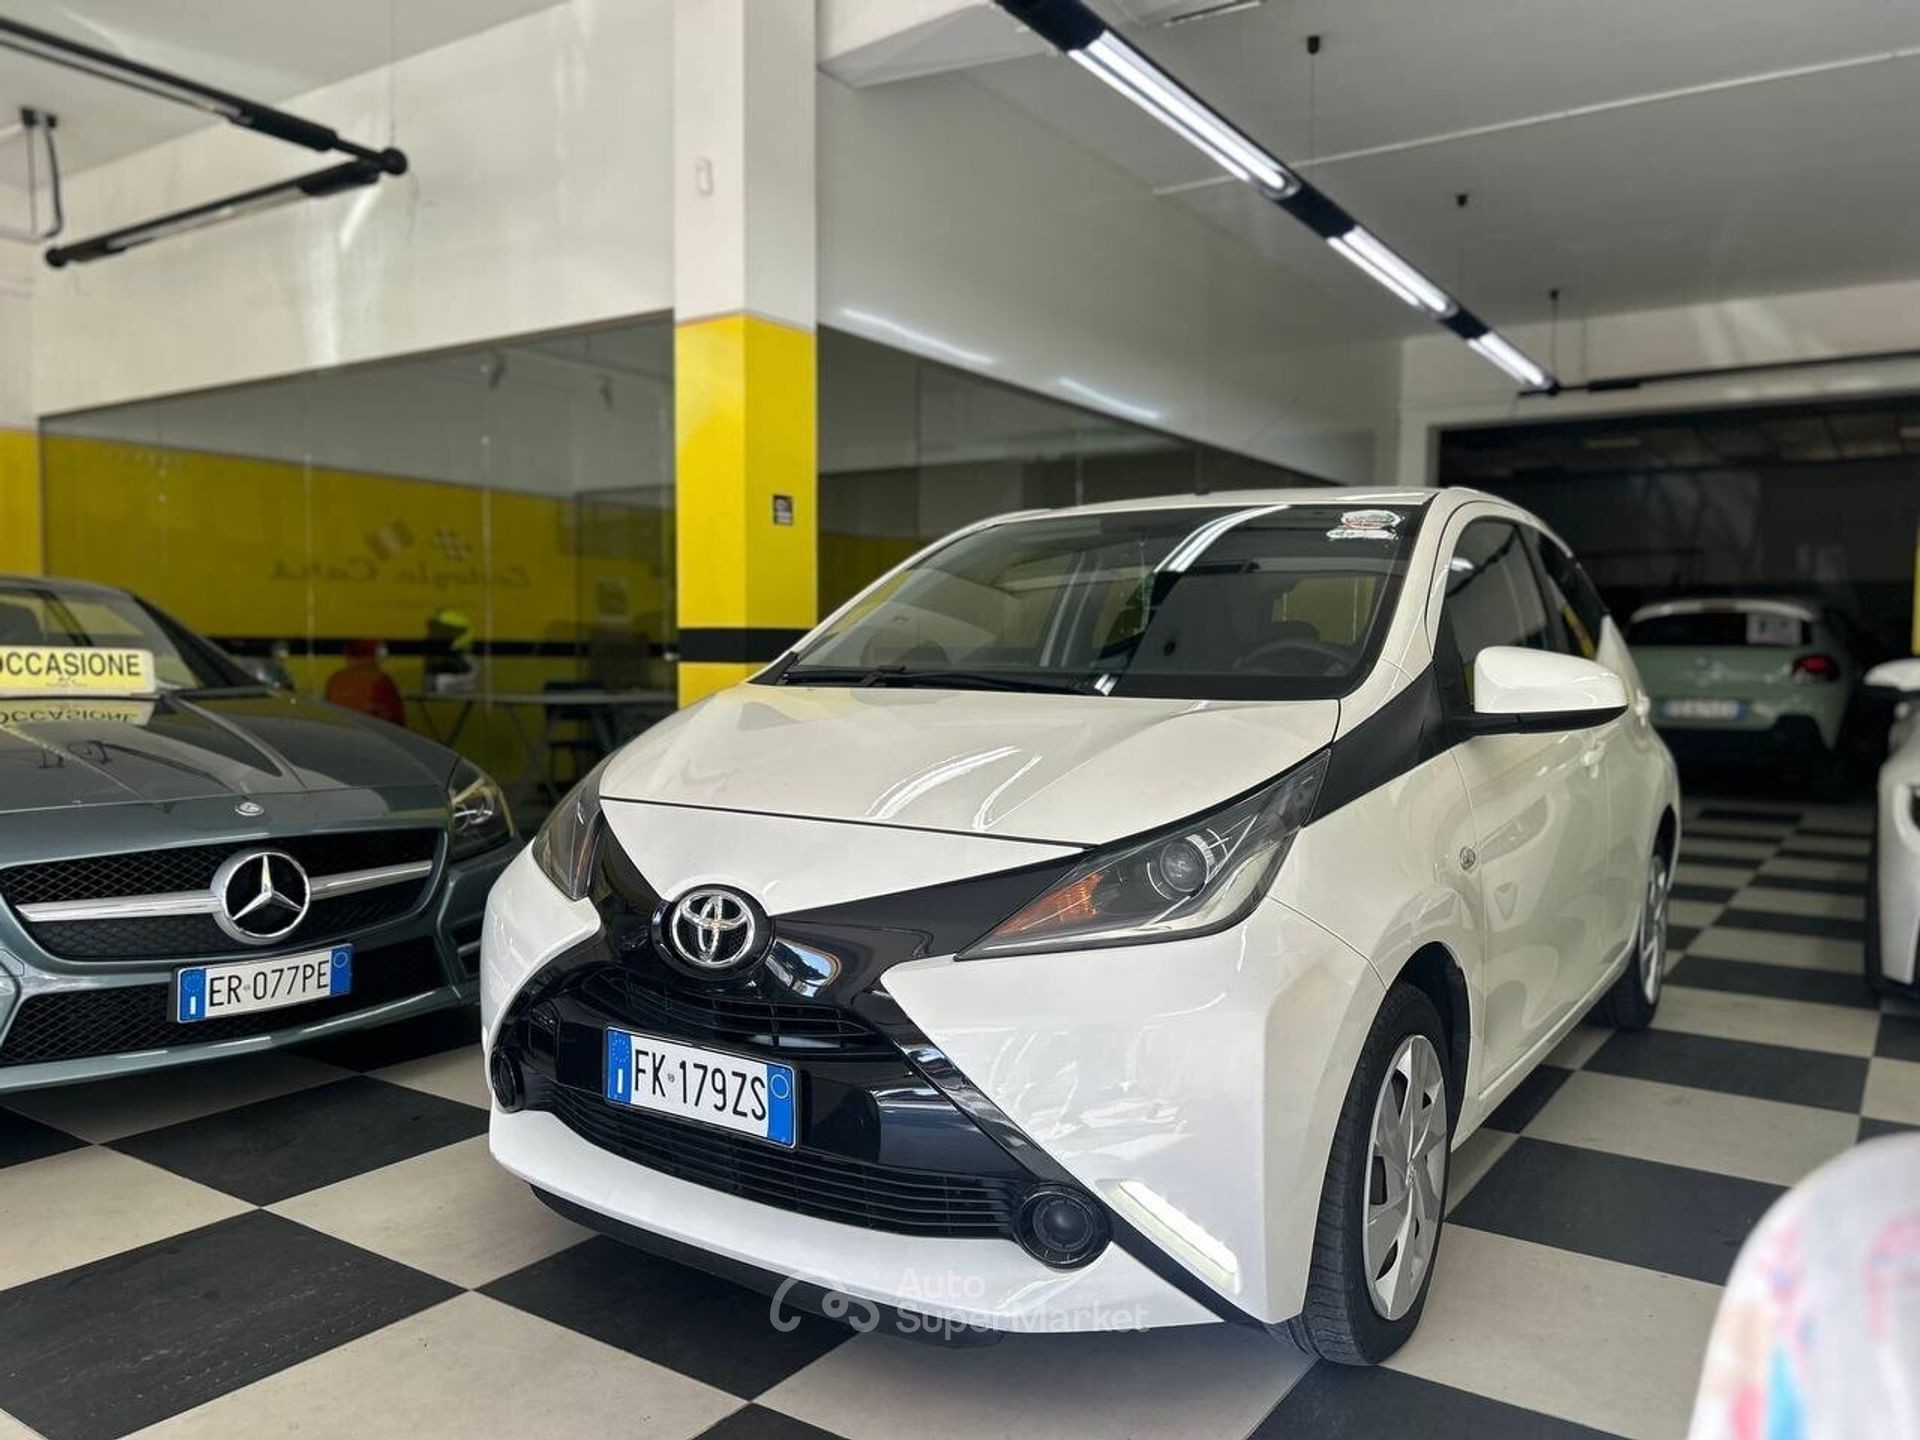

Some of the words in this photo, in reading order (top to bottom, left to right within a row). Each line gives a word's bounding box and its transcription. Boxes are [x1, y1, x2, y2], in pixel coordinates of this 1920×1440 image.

[0, 652, 140, 676] CCASIONE
[209, 974, 242, 1007] ER
[253, 960, 329, 1000] 077PE
[634, 1049, 666, 1098] FK
[679, 1060, 767, 1121] 179ZS
